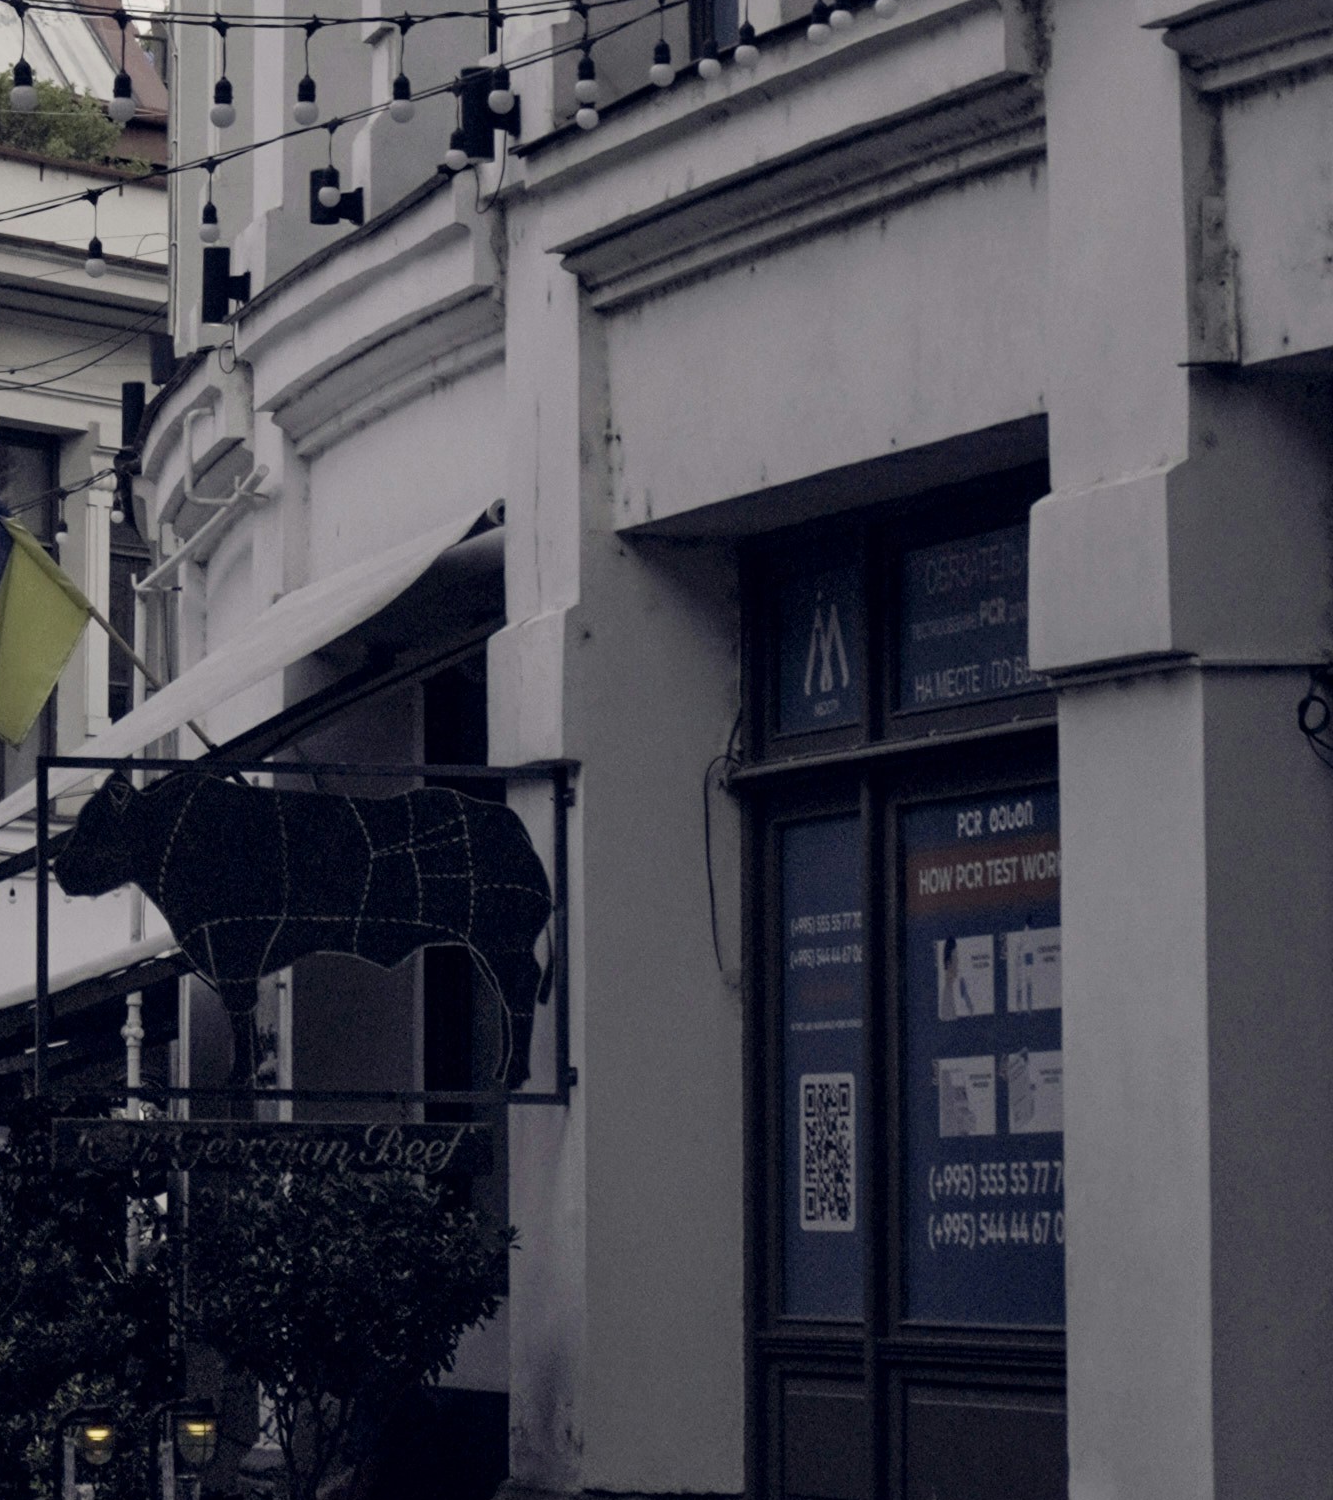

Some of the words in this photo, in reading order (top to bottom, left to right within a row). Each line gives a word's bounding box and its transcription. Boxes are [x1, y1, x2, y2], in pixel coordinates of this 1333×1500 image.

[956, 809, 983, 838] PCR
[918, 865, 953, 896] HOW
[955, 861, 984, 891] PCR
[985, 856, 1019, 887] TEST
[1021, 850, 1061, 882] WOR
[357, 1121, 464, 1175] Beef
[929, 1164, 976, 1202] (+995)
[980, 1161, 1007, 1196] 555
[1010, 1161, 1029, 1195] 55
[1032, 1160, 1050, 1194] 77
[1053, 1160, 1063, 1193] 7
[928, 1212, 976, 1251] (+995)
[979, 1211, 1007, 1246] 544
[1010, 1211, 1029, 1245] 44
[1032, 1211, 1051, 1245] 67
